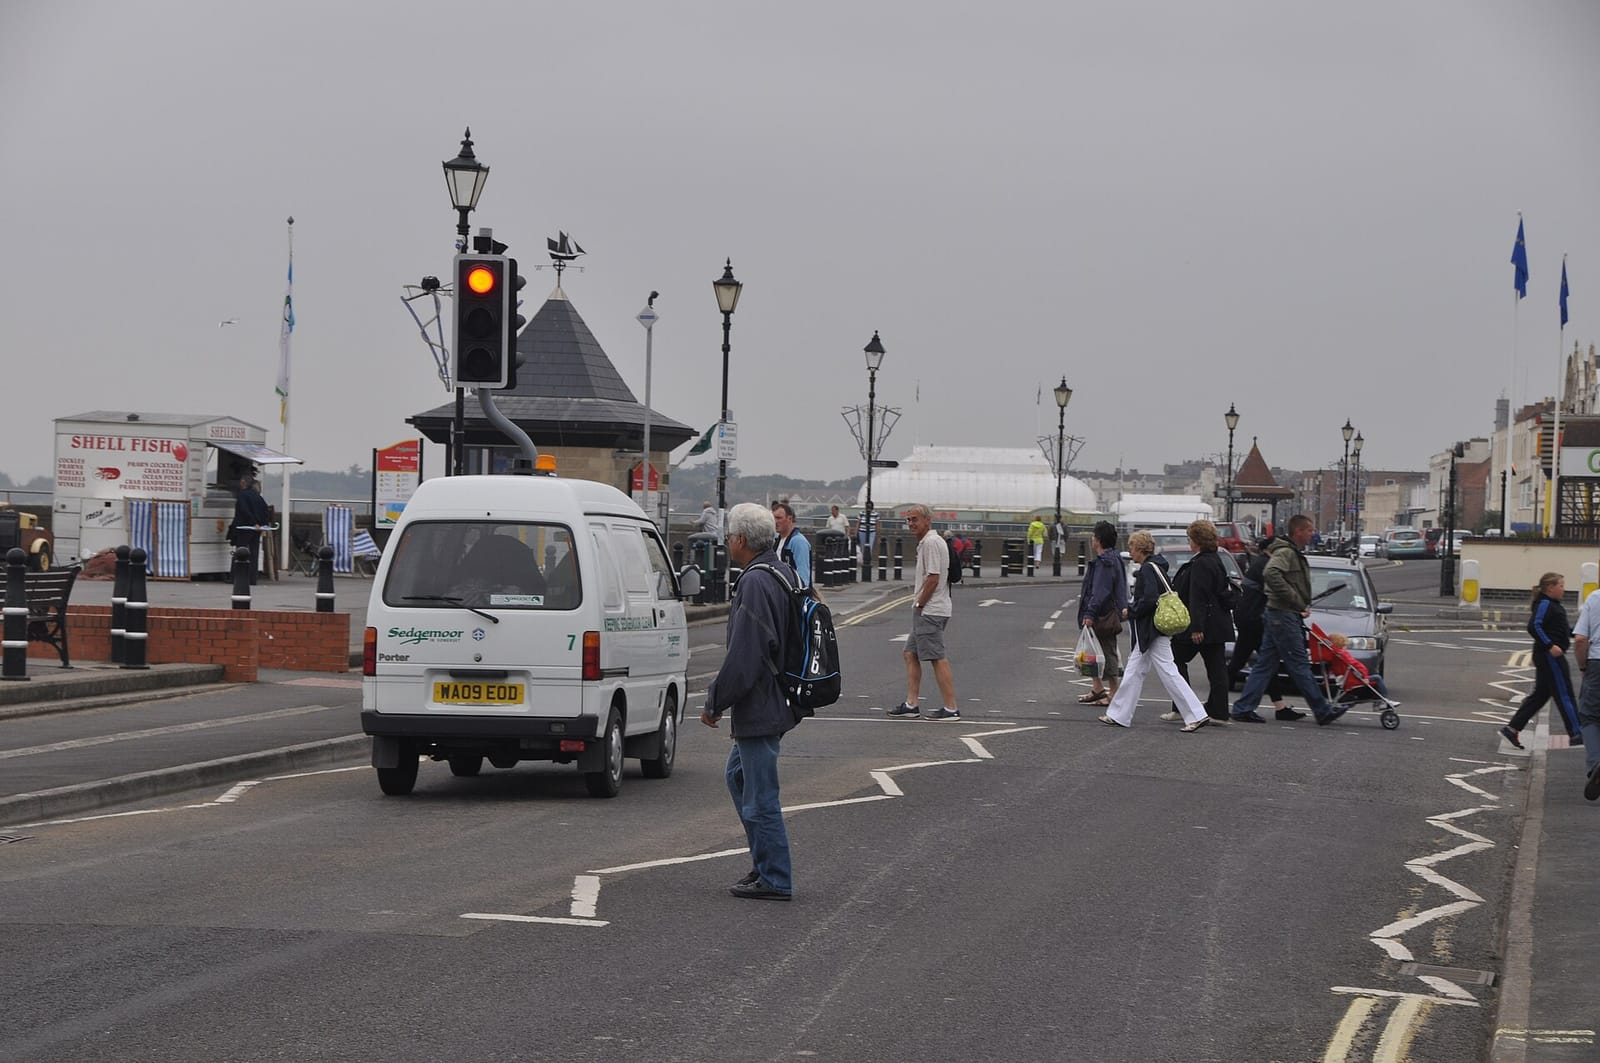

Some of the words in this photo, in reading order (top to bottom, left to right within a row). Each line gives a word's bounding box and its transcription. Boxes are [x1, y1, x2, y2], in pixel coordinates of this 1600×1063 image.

[209, 426, 246, 439] SHELLFISH
[71, 435, 126, 451] SHELL
[131, 438, 172, 453] FISH
[387, 627, 465, 645] Sedgemoor
[567, 634, 576, 651] 7
[378, 653, 410, 662] Porter
[440, 684, 482, 700] WA09
[486, 686, 518, 701] EOD
